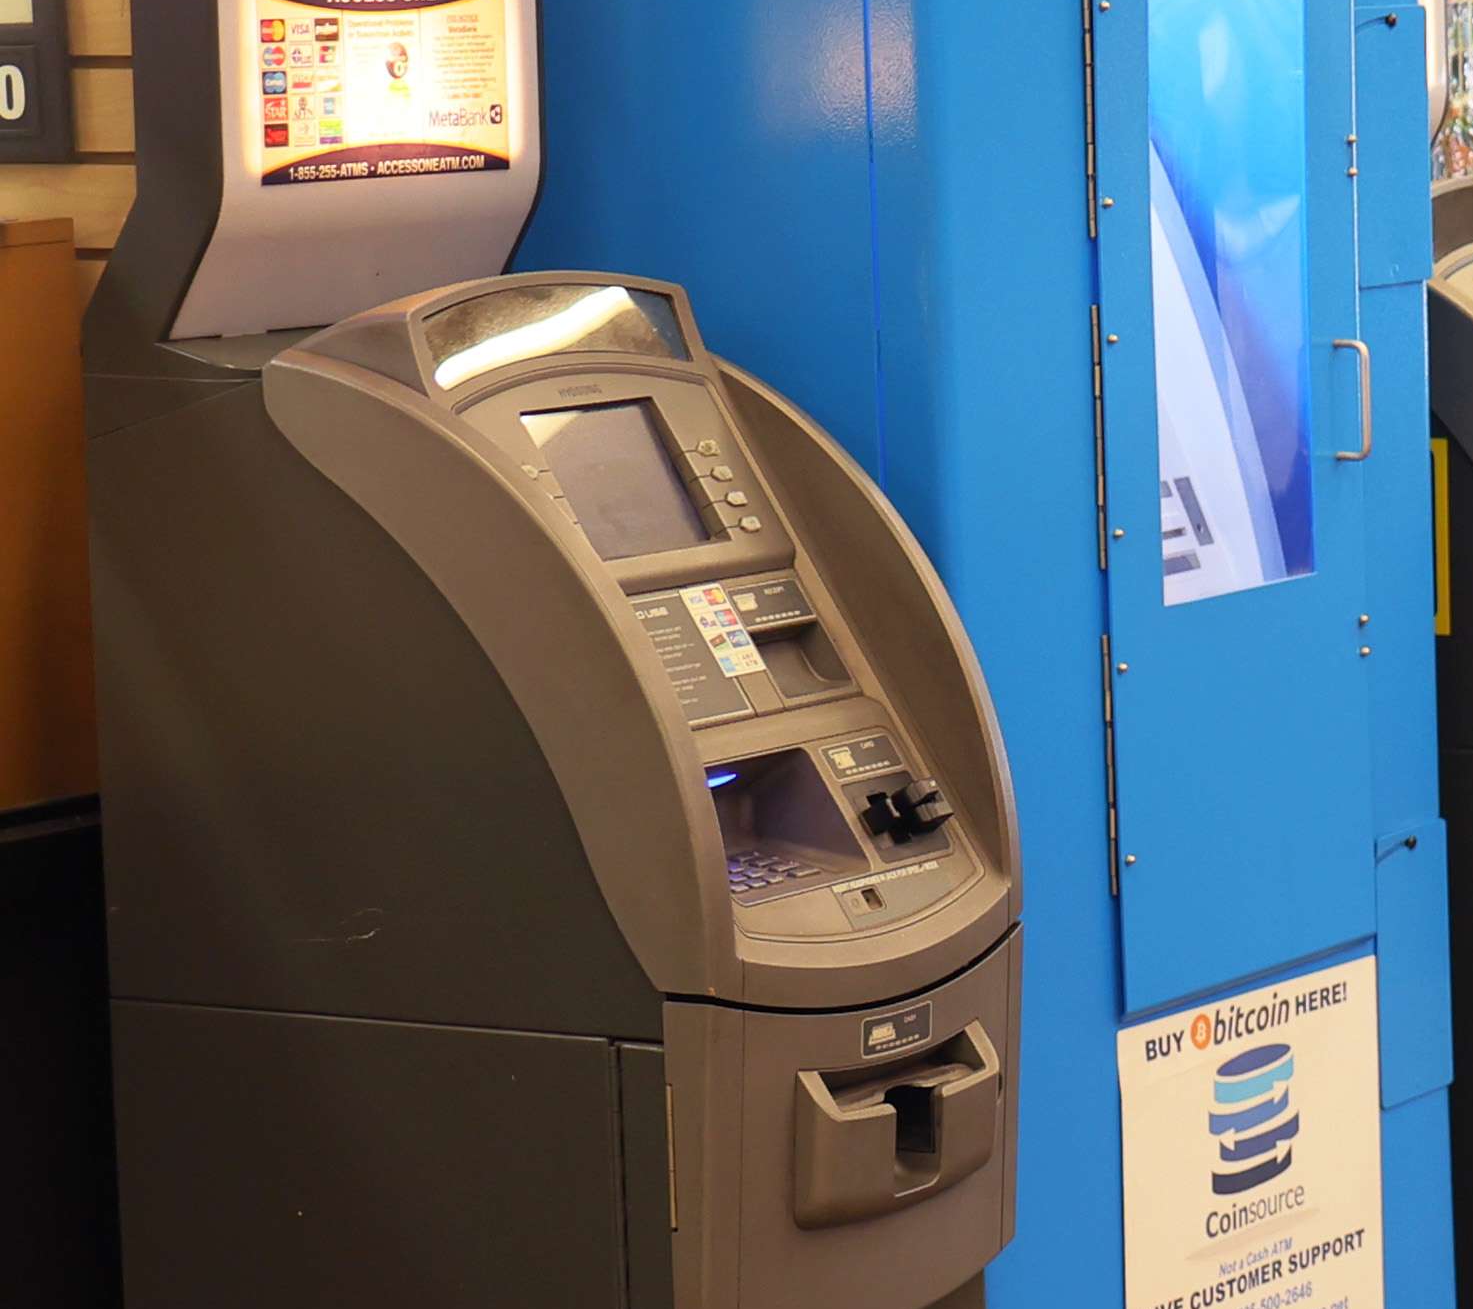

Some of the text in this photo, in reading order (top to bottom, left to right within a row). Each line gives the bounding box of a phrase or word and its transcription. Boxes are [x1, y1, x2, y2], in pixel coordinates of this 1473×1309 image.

[428, 106, 488, 128] MetaBank
[288, 154, 486, 181] 1-855-255-ATMS ACCESSONEATM.COM
[1145, 981, 1348, 1062] BUY bitcoin HERE!
[1205, 1185, 1305, 1239] Coinsource
[1218, 1259, 1237, 1277] Not
[1246, 1248, 1269, 1267] Cash
[1271, 1237, 1293, 1257] ATM
[1287, 1228, 1365, 1274] SUPPORT
